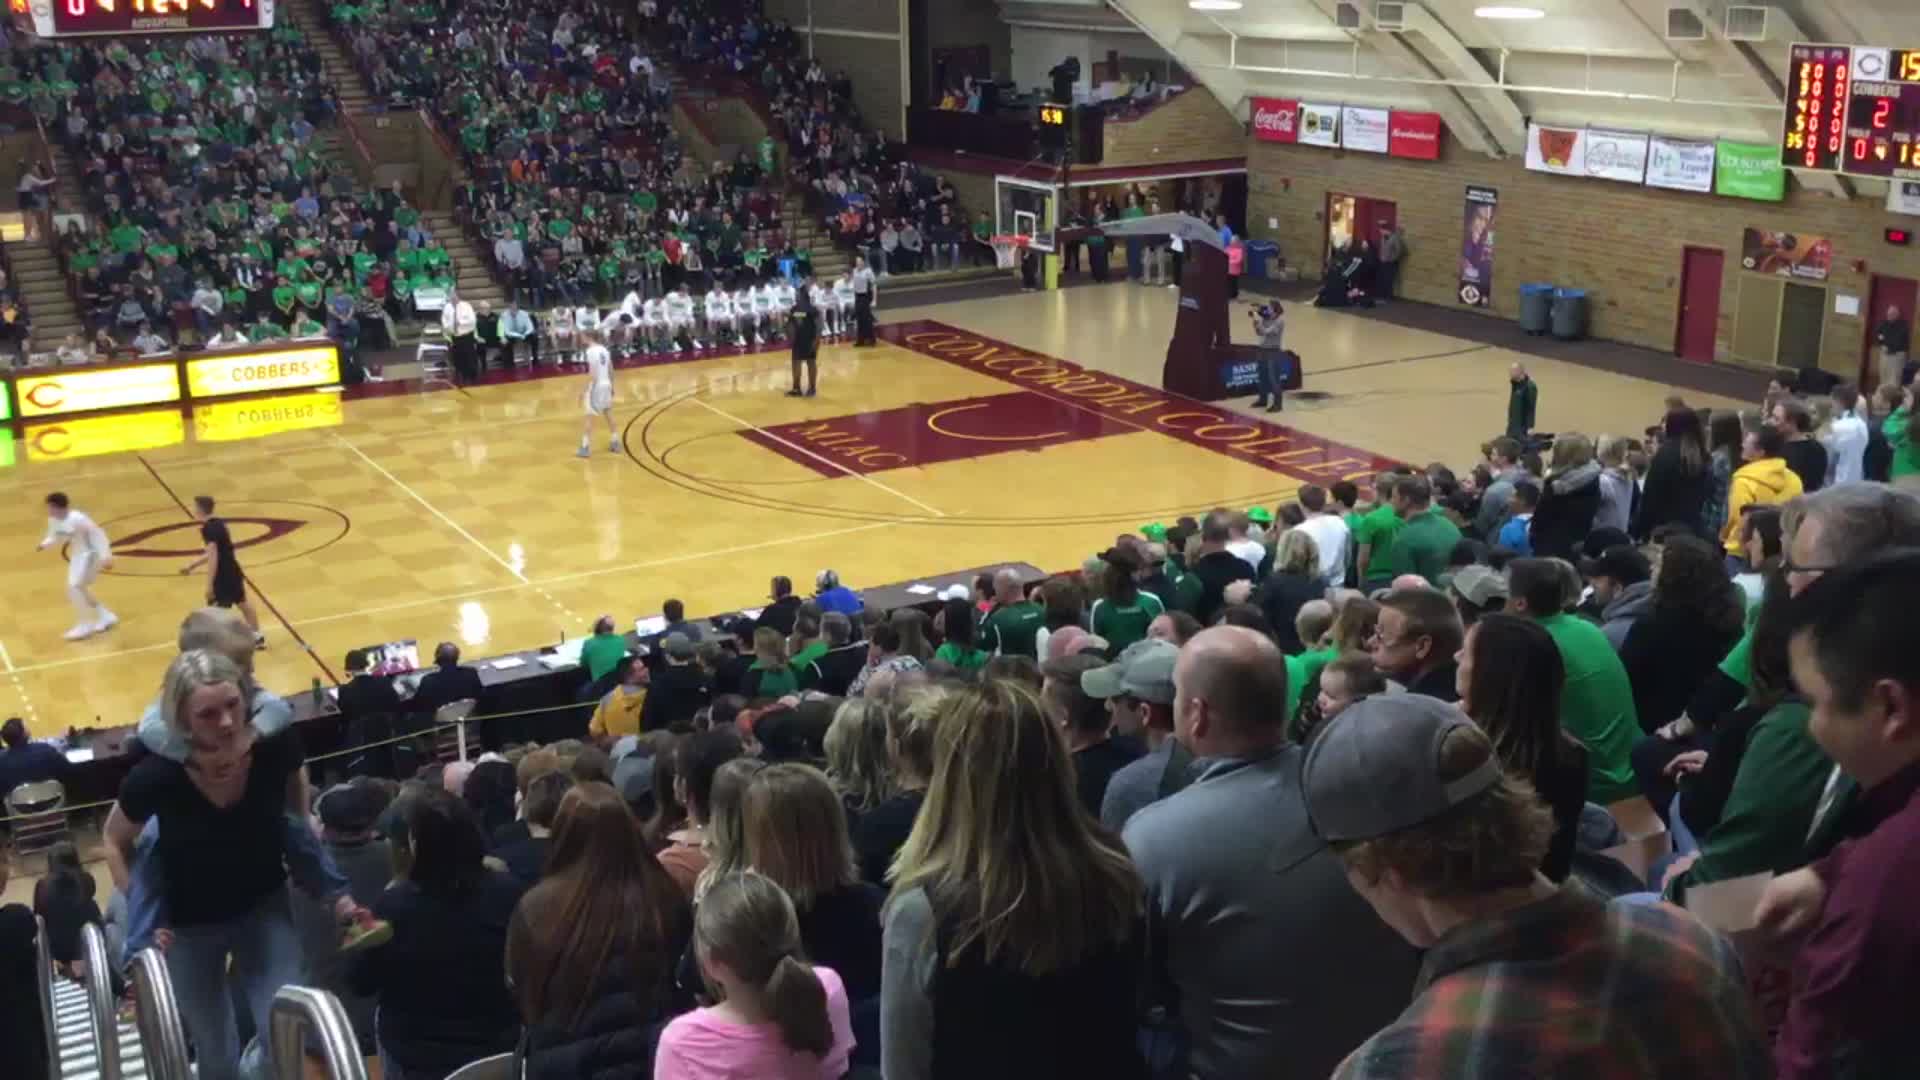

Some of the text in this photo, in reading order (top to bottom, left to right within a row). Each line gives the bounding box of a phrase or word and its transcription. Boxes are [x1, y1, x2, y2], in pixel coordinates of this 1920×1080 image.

[1814, 63, 1824, 79] 0
[1836, 65, 1846, 81] 0
[1812, 80, 1822, 96] 0
[1834, 82, 1844, 98] 0
[1810, 99, 1820, 115] 0
[1832, 100, 1842, 116] 2
[1873, 100, 1890, 128] 2
[1808, 115, 1818, 132] 0
[1831, 117, 1841, 133] 0
[1807, 133, 1817, 150] 0
[1829, 135, 1839, 152] 0
[1854, 139, 1867, 160] 0
[1806, 151, 1816, 167] 0
[232, 361, 311, 382] COBBERS
[905, 331, 1168, 414] CONCORDIA
[790, 423, 908, 466] MIAC
